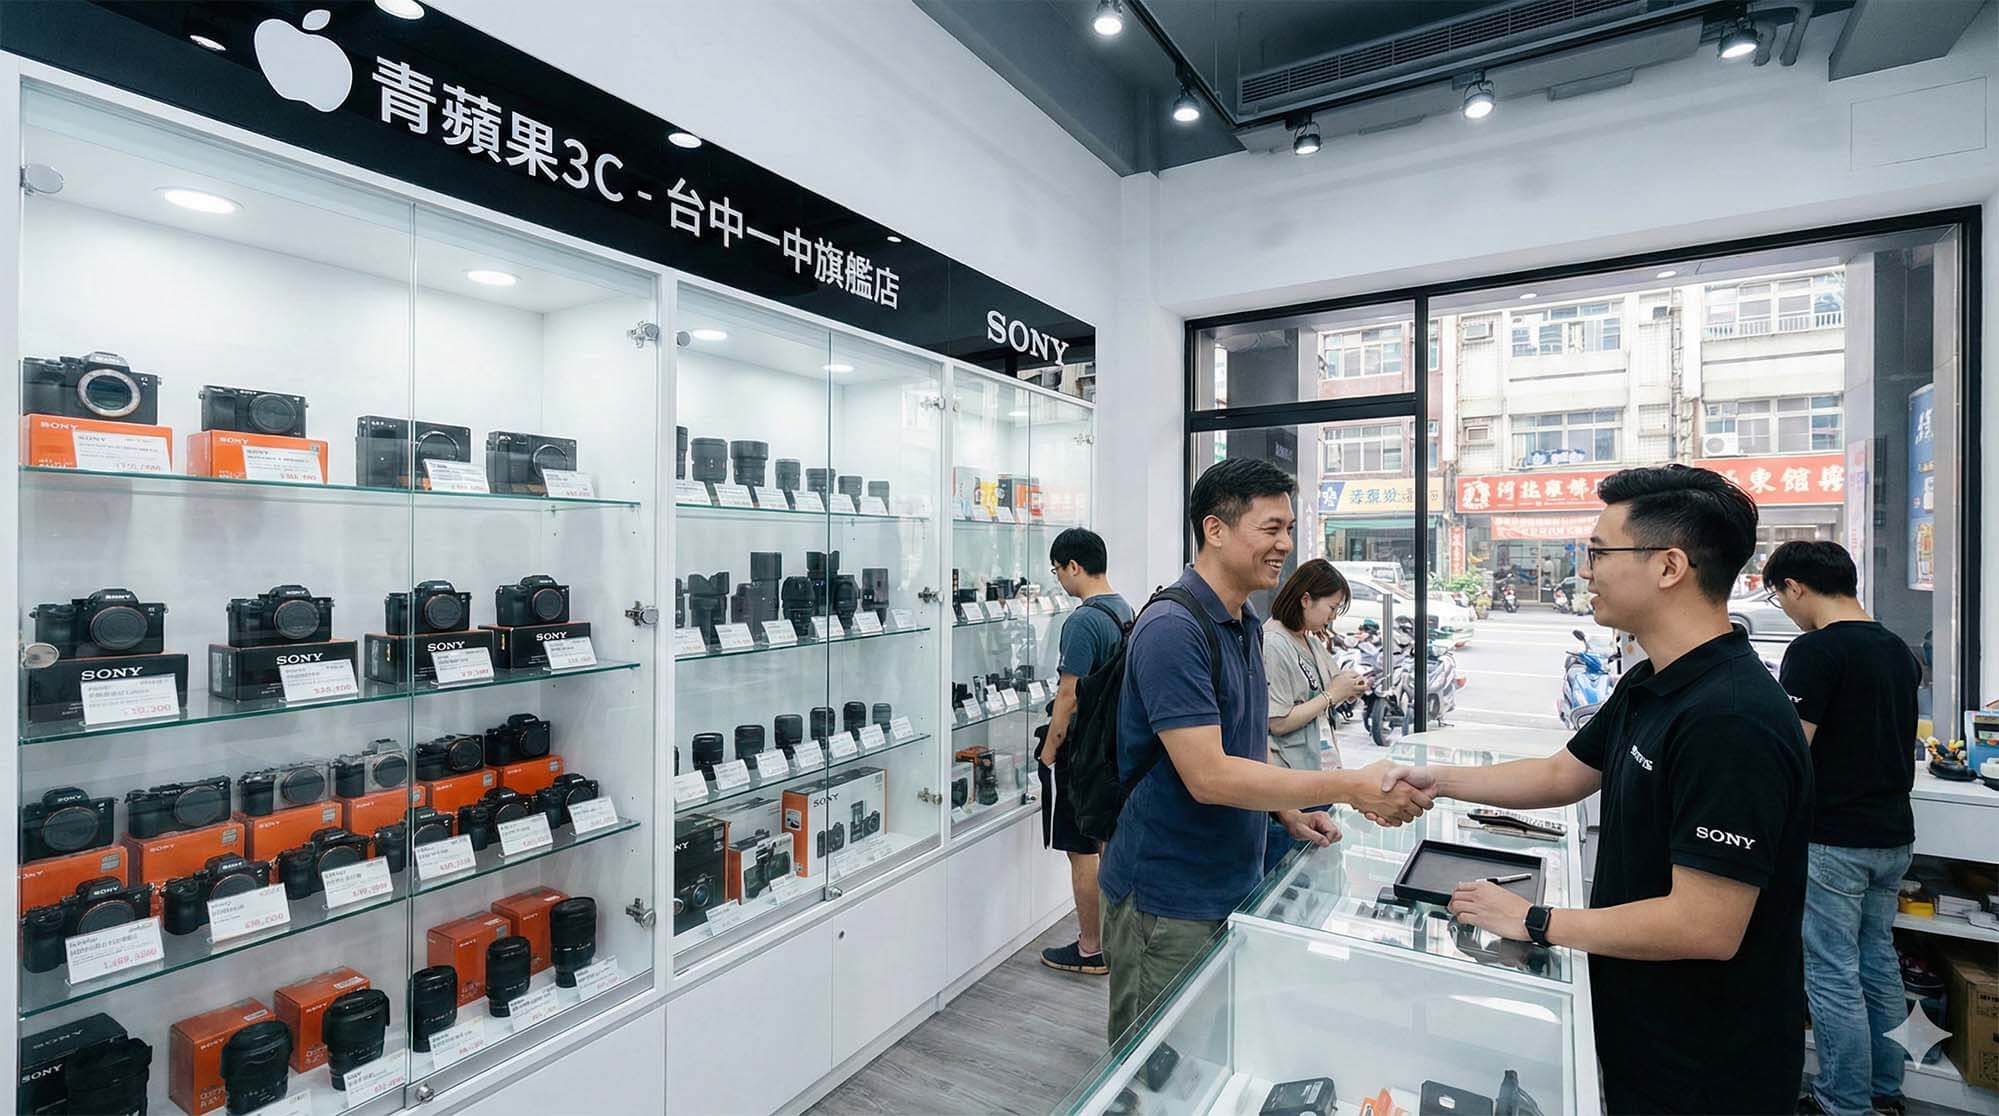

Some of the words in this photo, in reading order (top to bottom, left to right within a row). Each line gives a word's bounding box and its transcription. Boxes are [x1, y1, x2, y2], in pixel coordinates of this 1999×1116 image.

[372, 56, 623, 203] 青蘋果3C
[667, 177, 900, 309] 台中一中旗艦店
[986, 309, 1069, 366] SONY
[427, 640, 465, 652] SONY
[536, 631, 567, 641] SONY
[276, 652, 324, 666] SONY
[81, 666, 143, 681] SONY
[1696, 826, 1755, 850] SONY
[32, 1029, 84, 1049] SONY
[21, 1063, 64, 1084] SONY
